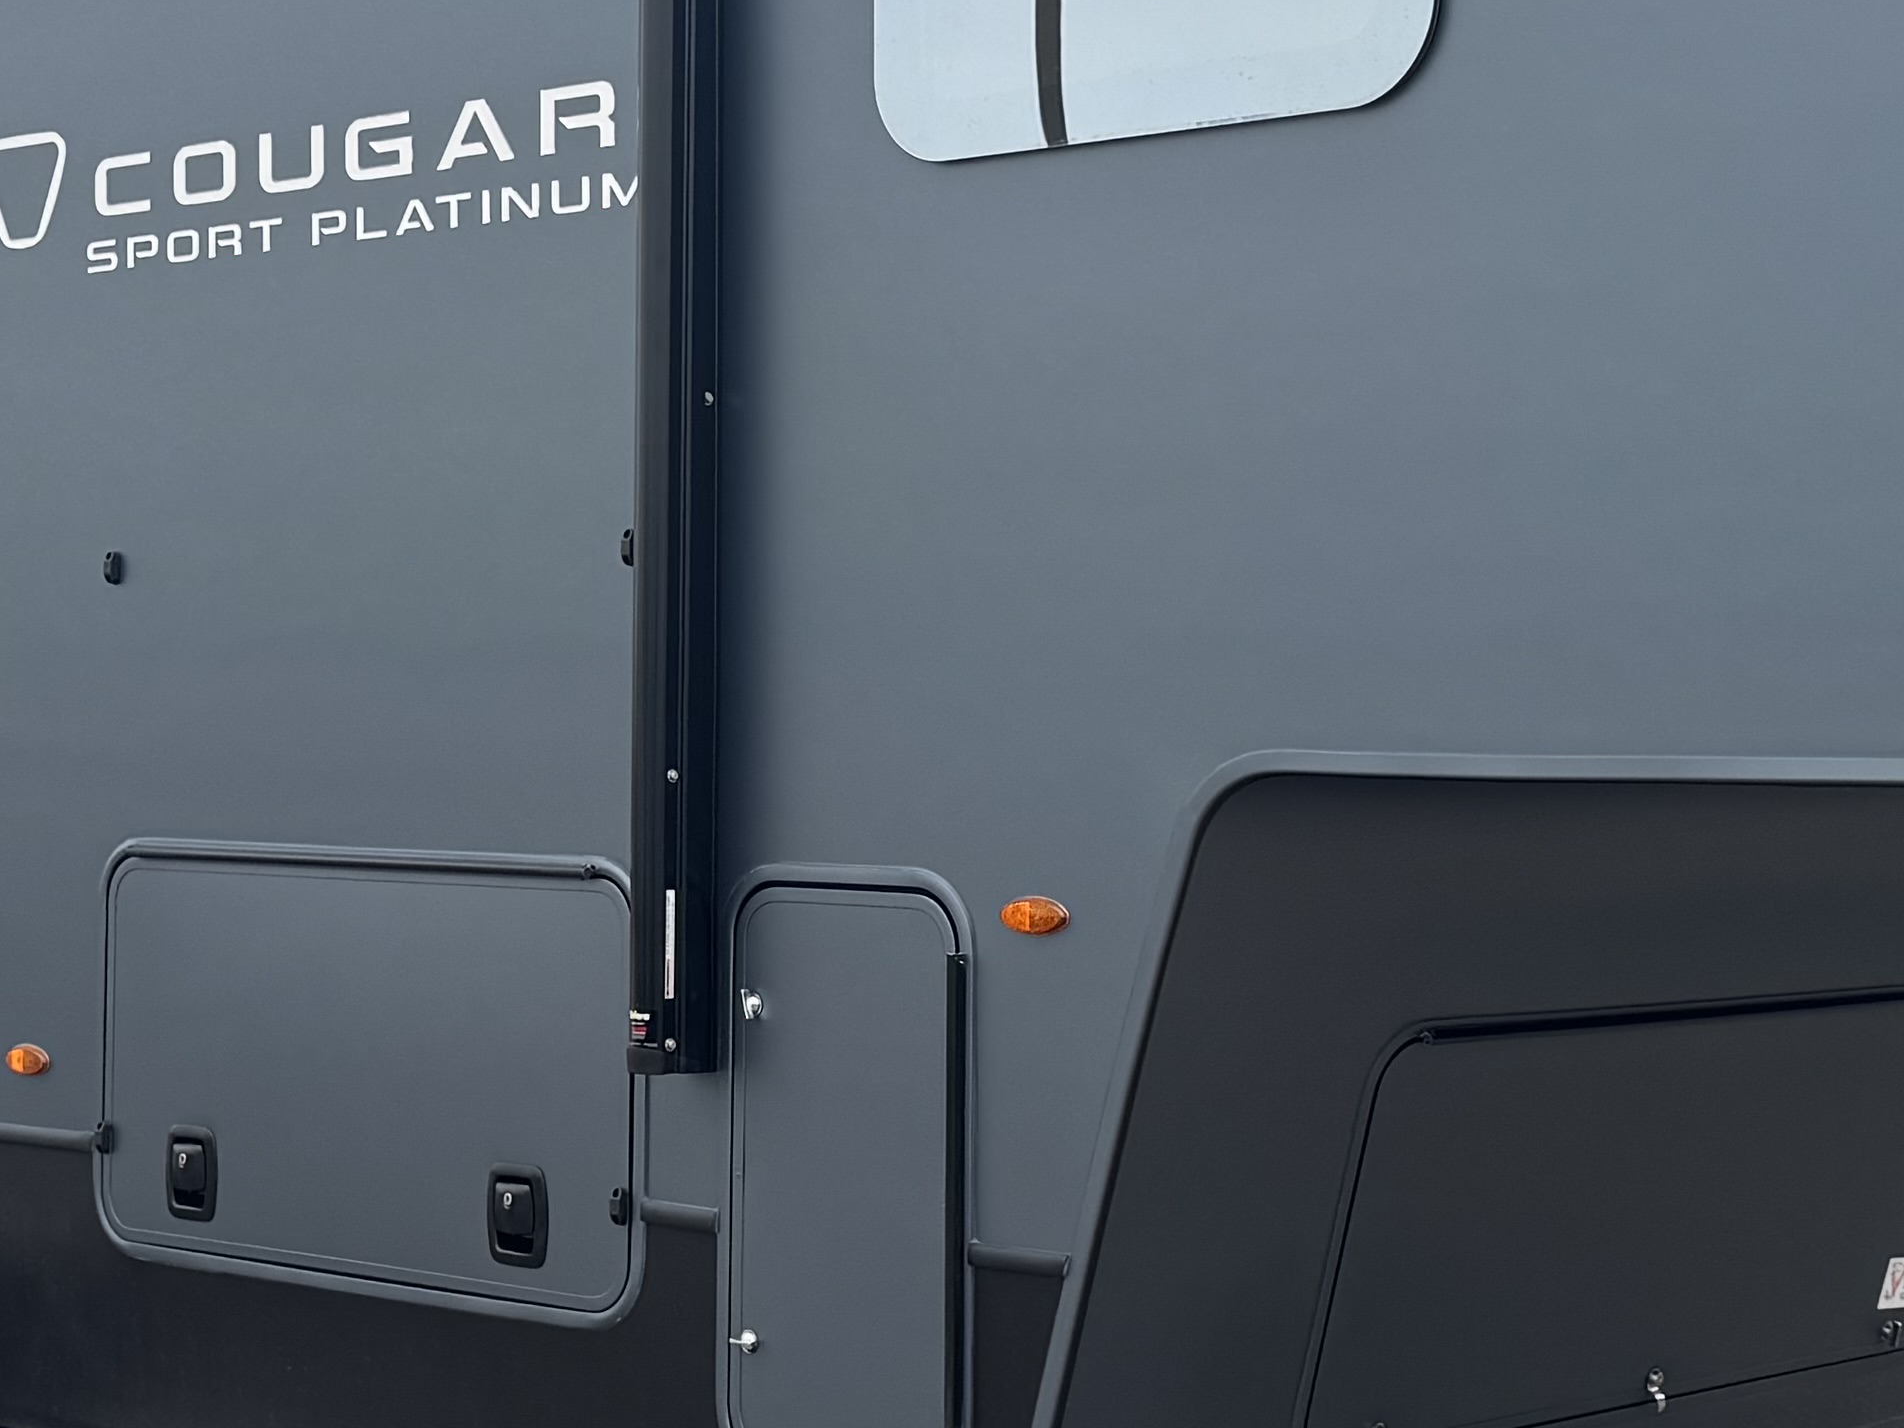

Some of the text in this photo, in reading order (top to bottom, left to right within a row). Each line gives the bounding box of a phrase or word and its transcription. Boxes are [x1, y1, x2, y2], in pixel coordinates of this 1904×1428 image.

[93, 80, 617, 218] COUGAR
[85, 172, 639, 274] SPORT PLATINUM
